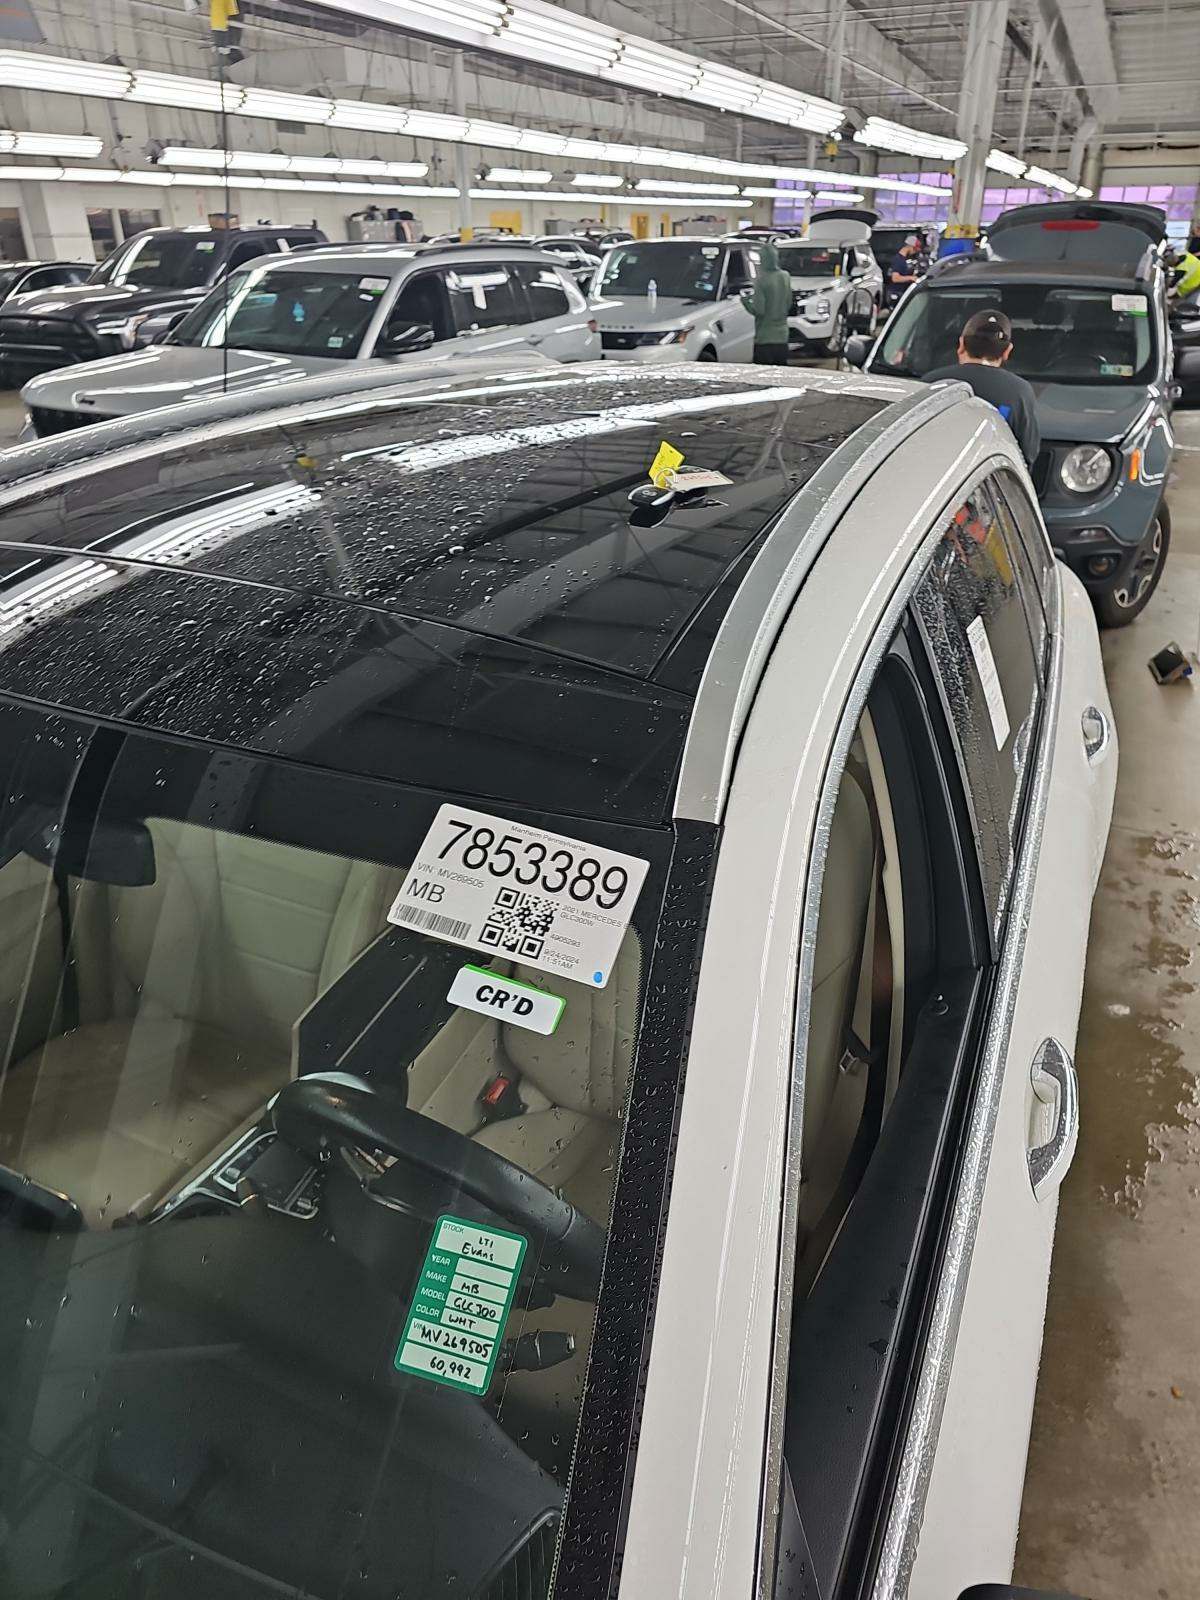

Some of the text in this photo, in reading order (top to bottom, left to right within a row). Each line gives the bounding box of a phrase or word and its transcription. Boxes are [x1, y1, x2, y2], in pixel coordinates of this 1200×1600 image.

[437, 819, 629, 910] 7853389
[406, 878, 446, 903] MB
[580, 911, 622, 928] MERCEDES
[475, 984, 534, 1017] CR'D
[443, 1222, 465, 1234] STOCK
[431, 1254, 451, 1266] YEAR
[425, 1270, 448, 1283] MAKE
[420, 1287, 446, 1301] MODEL
[415, 1304, 440, 1318] COLOR
[448, 1314, 477, 1330] WHT
